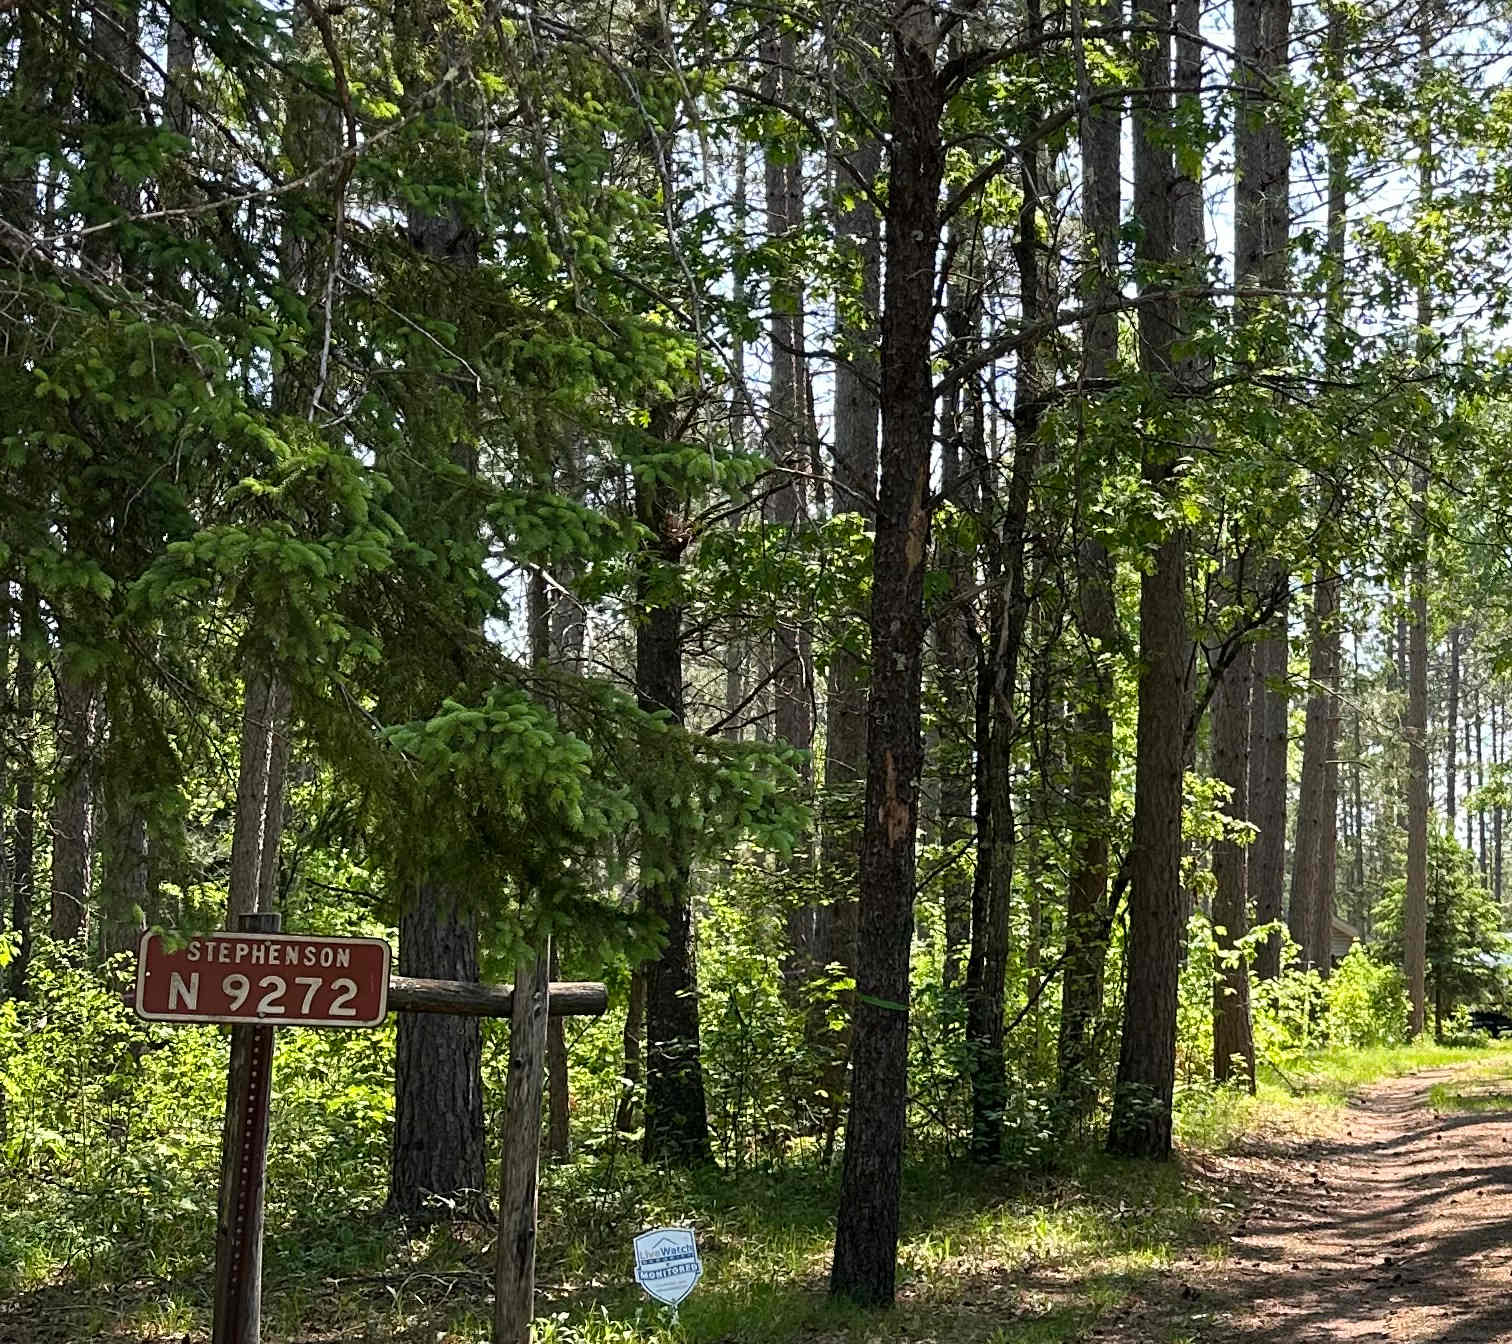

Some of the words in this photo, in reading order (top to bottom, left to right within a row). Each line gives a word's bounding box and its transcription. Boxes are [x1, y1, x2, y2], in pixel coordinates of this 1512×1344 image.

[187, 941, 350, 968] STEPHENSON
[168, 971, 199, 1010] N
[222, 973, 358, 1017] 9272
[640, 1263, 698, 1280] MONITORED
